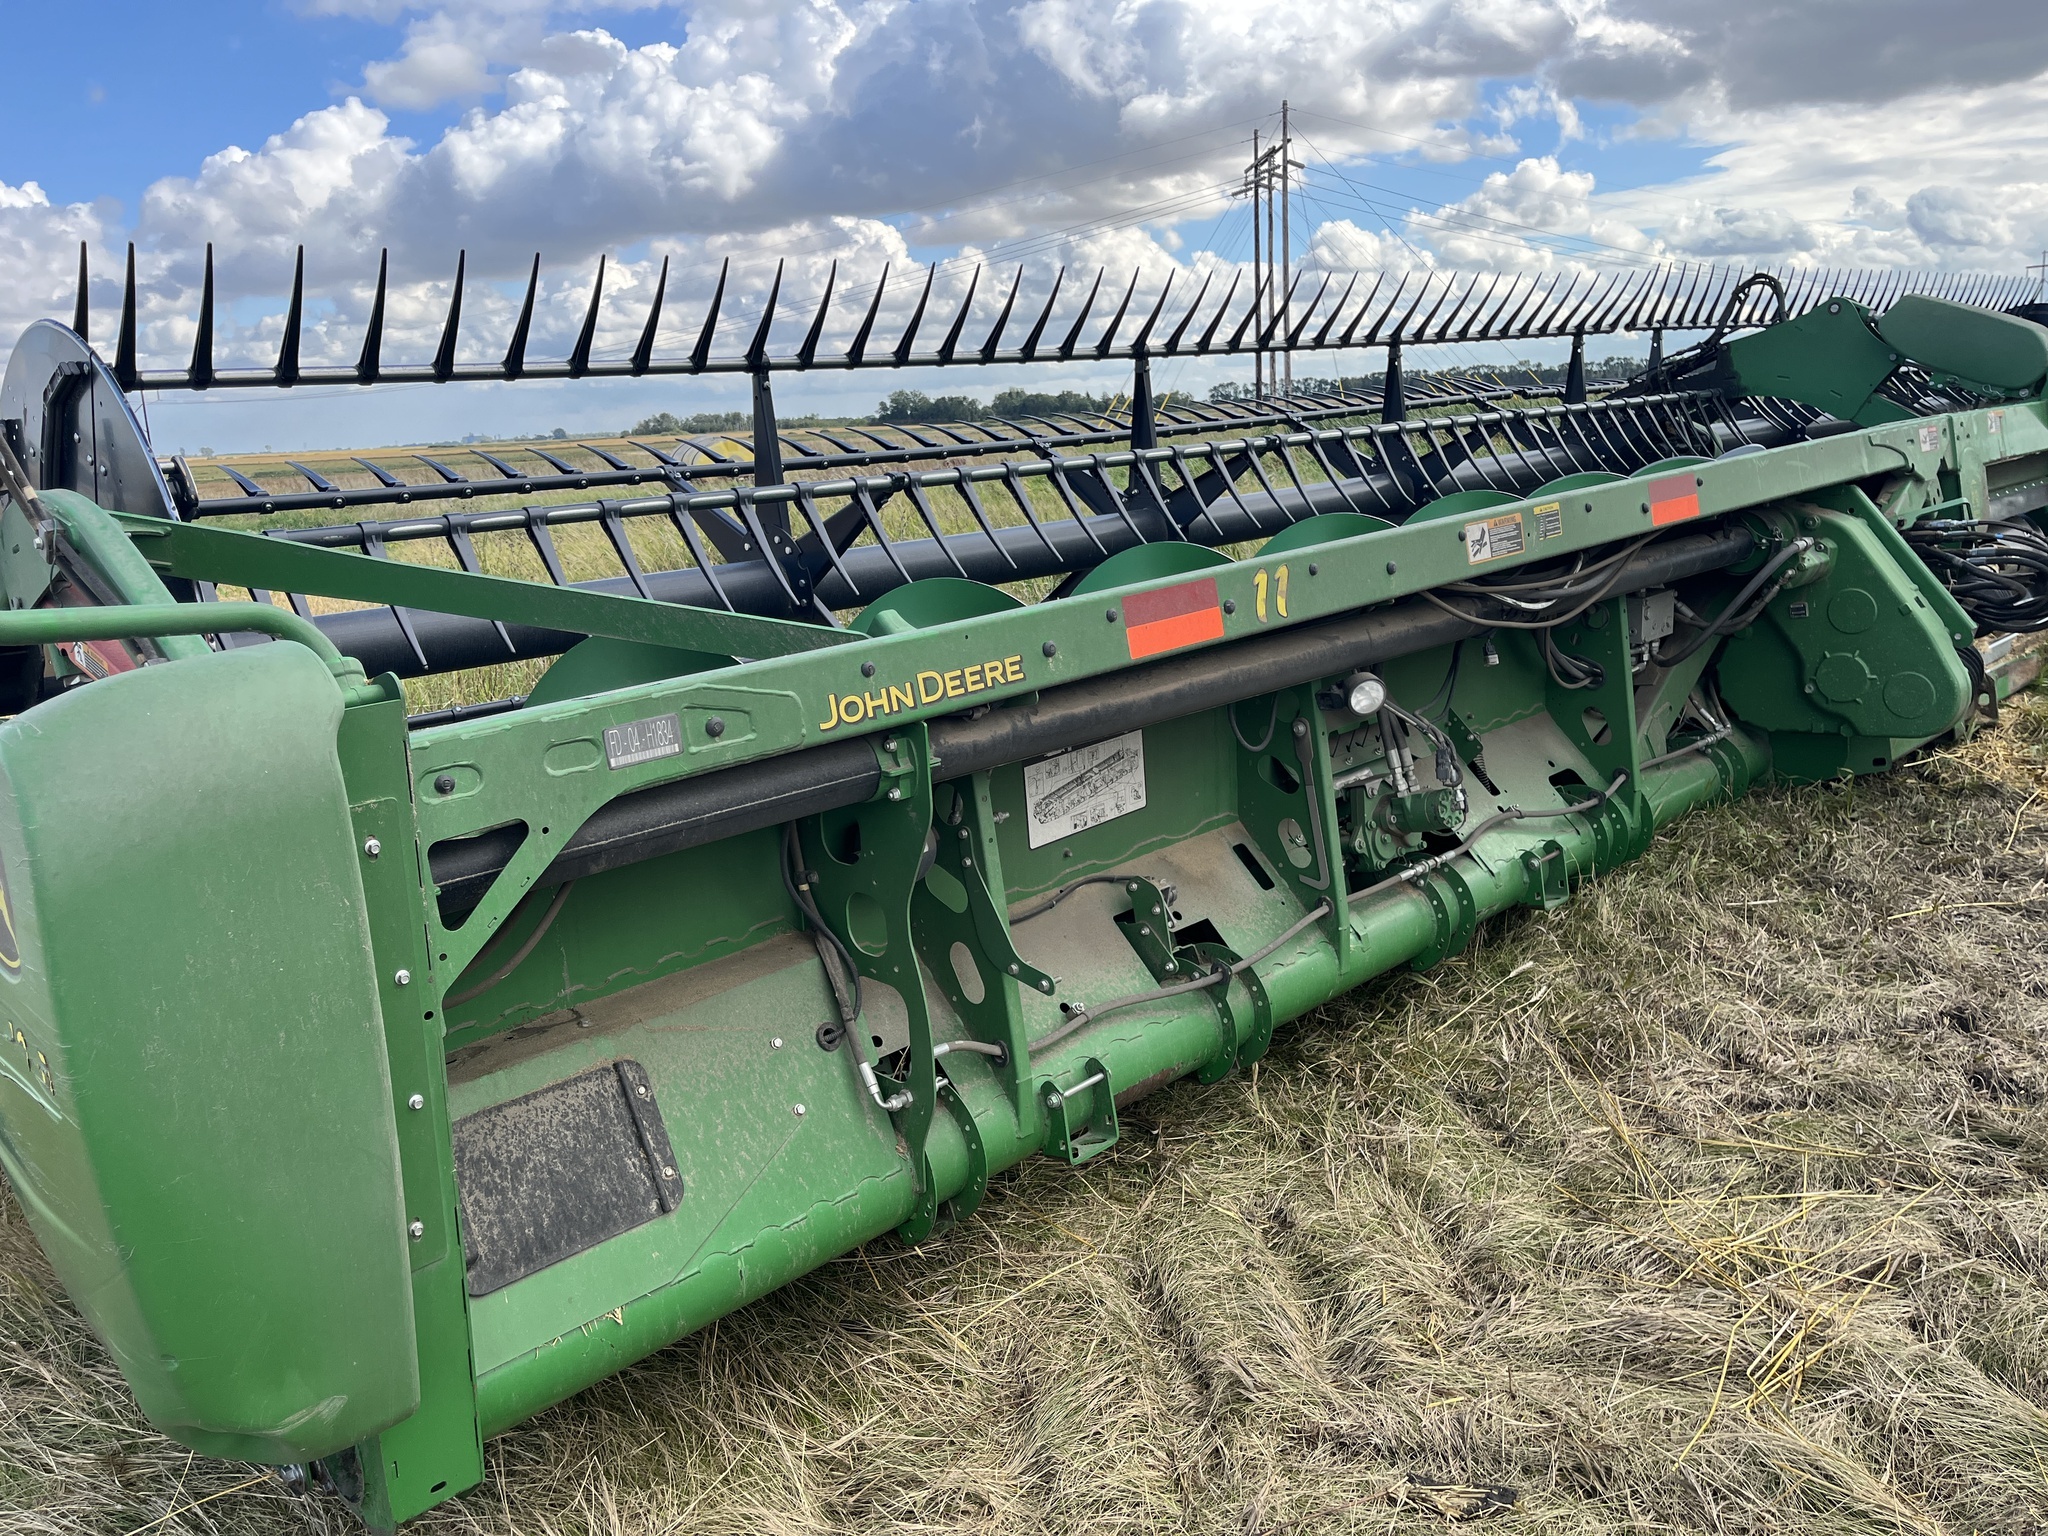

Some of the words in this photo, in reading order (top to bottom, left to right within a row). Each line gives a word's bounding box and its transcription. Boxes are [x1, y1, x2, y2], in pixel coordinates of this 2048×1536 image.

[1253, 564, 1289, 623] 11
[819, 681, 916, 731] JOHN
[916, 654, 1025, 705] DEERE
[608, 729, 623, 757] FD
